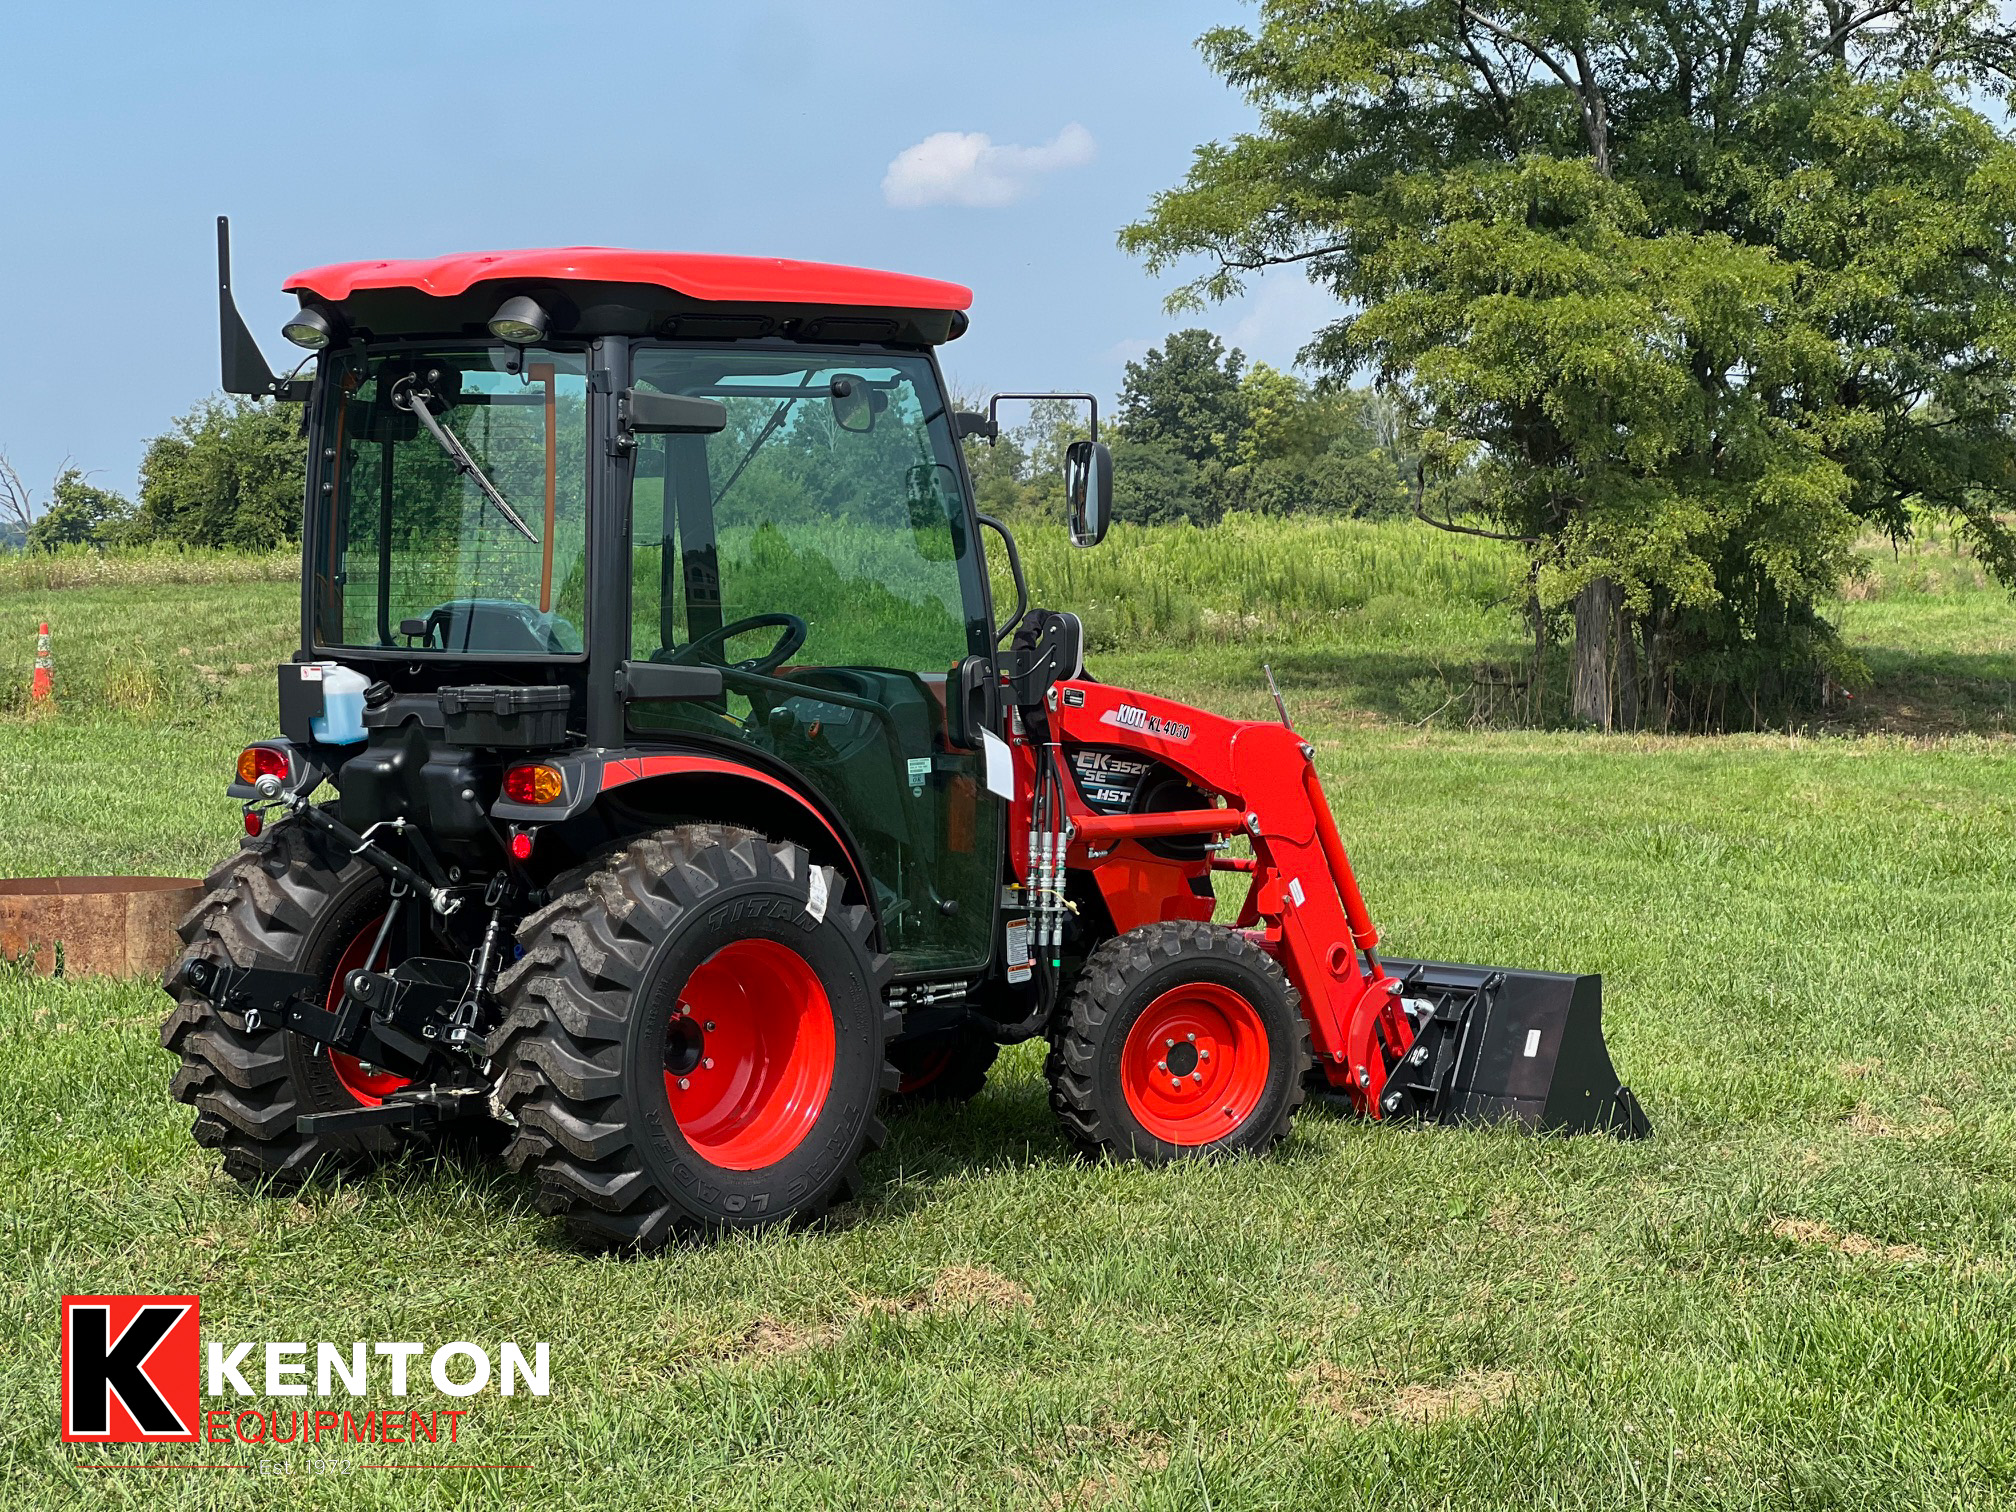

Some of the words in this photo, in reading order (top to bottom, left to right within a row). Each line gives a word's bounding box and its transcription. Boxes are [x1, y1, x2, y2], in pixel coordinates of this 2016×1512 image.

[1116, 703, 1147, 728] KIOTI
[1148, 716, 1161, 732] KL
[1163, 720, 1190, 740] 4030
[1083, 769, 1108, 783] SE
[1096, 788, 1132, 803] HST
[708, 898, 820, 933] TITAN
[645, 1109, 771, 1213] LOADER
[788, 1103, 860, 1203] TRAC
